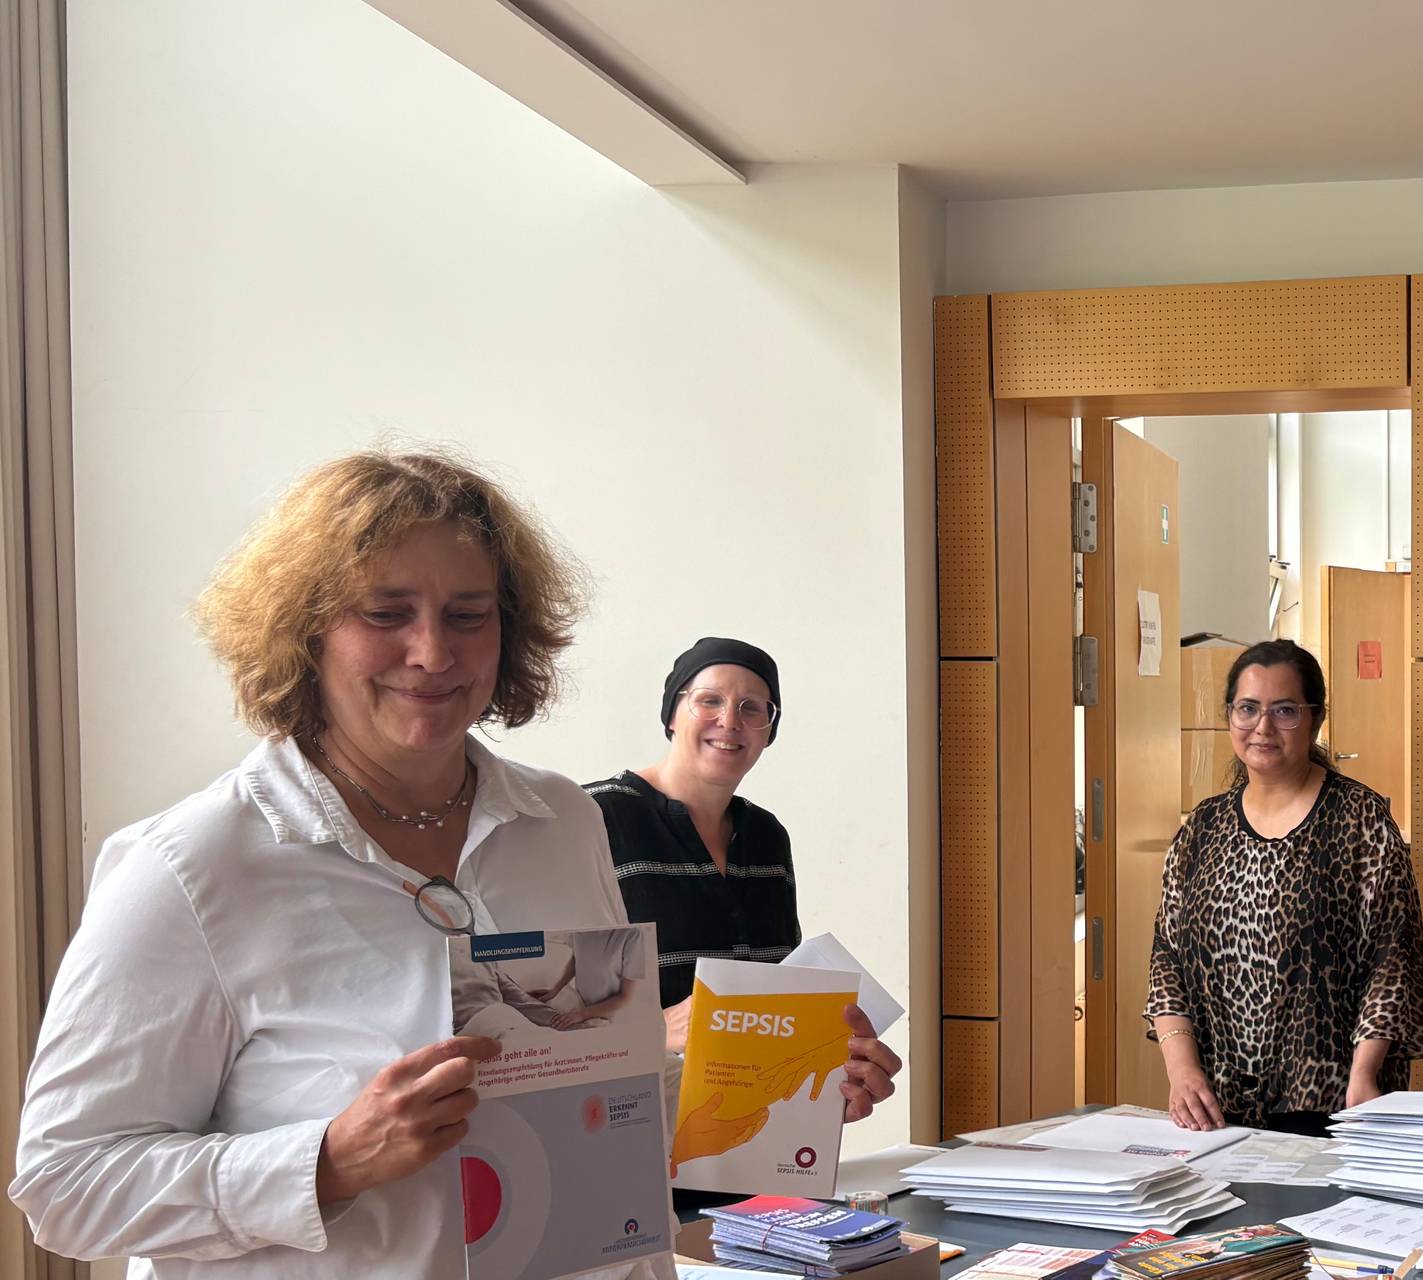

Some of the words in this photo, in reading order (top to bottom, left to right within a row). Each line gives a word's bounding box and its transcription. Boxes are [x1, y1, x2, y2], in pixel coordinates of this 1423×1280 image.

[709, 1009, 796, 1038] SEPSIS
[504, 1050, 522, 1063] geht
[609, 1111, 630, 1122] SEPSIS
